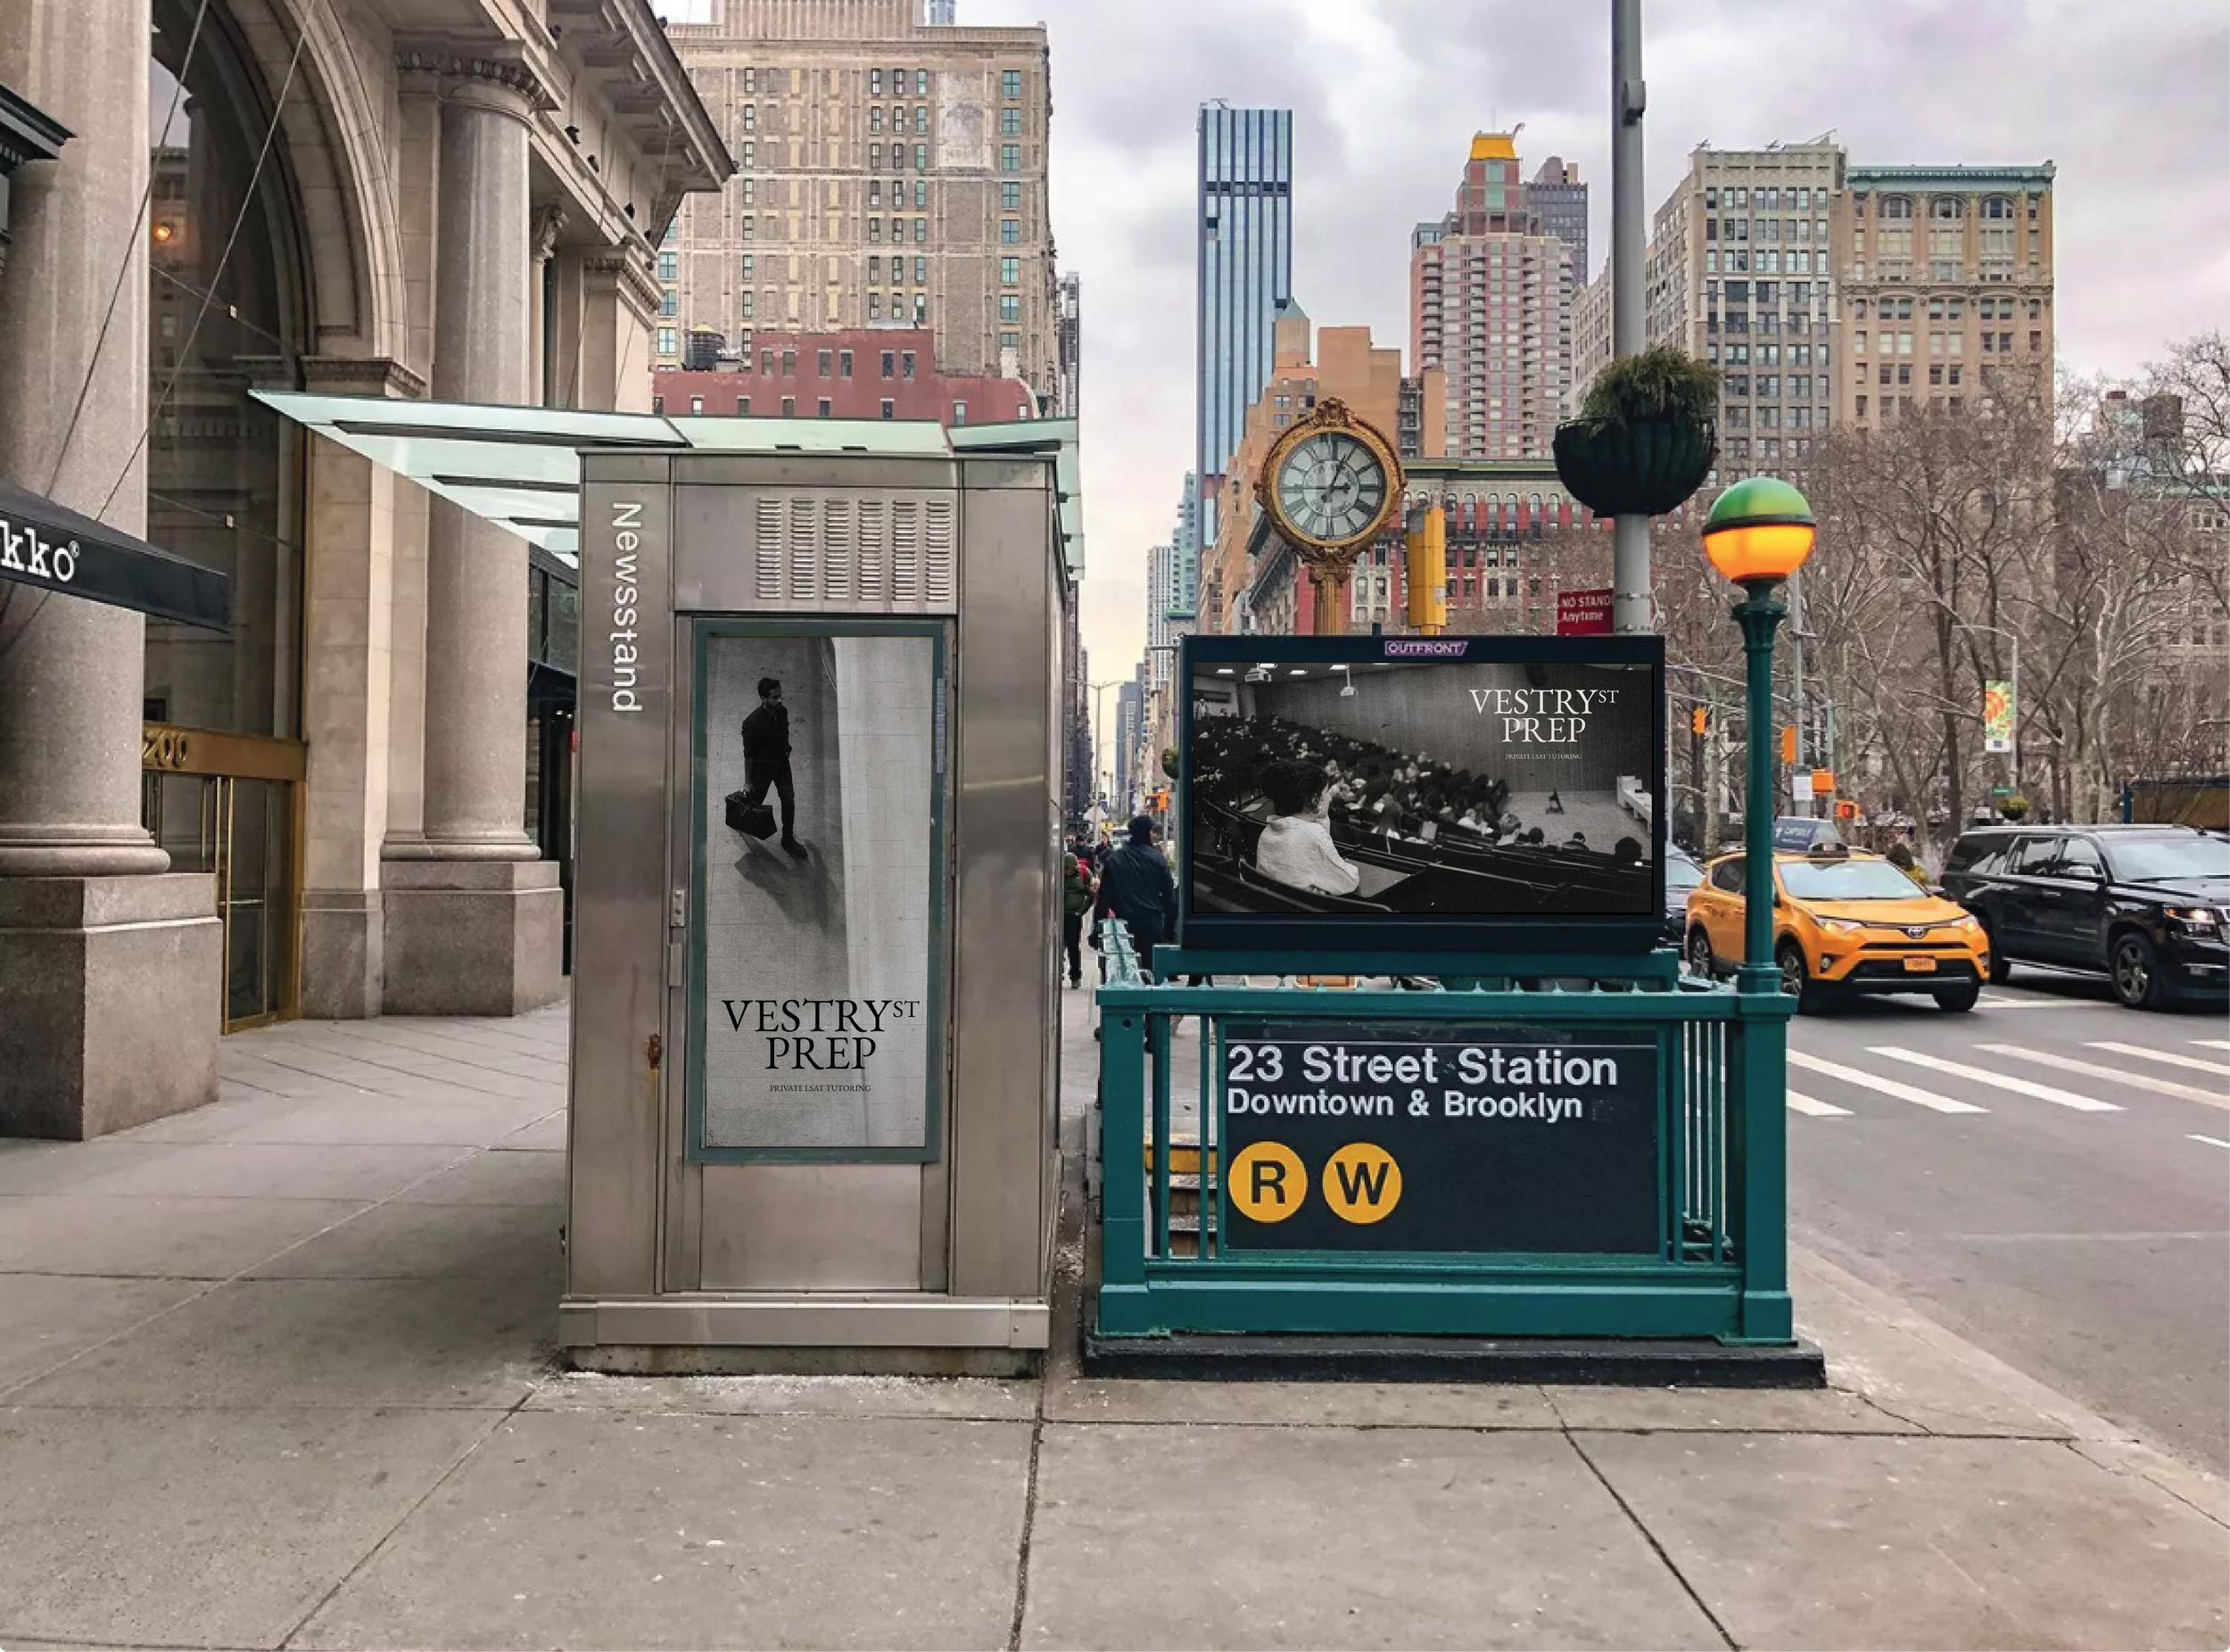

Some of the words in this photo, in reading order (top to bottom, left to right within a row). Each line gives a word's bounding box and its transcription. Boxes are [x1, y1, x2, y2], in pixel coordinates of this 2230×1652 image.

[610, 502, 643, 712] Newsstand
[1561, 610, 1603, 624] Anytime
[1562, 597, 1576, 607] NO
[1388, 643, 1461, 653] OUTFRONT
[1501, 717, 1586, 743] PREP
[764, 1037, 876, 1070] PREP
[1227, 1045, 1284, 1082] 23
[1302, 1045, 1439, 1083] Street
[1458, 1047, 1618, 1086] Station
[1227, 1087, 1393, 1115] Downtown
[1408, 1088, 1429, 1117] &
[1444, 1090, 1582, 1123] Brooklyn
[1251, 1160, 1285, 1204] R
[1335, 1161, 1390, 1207] W
